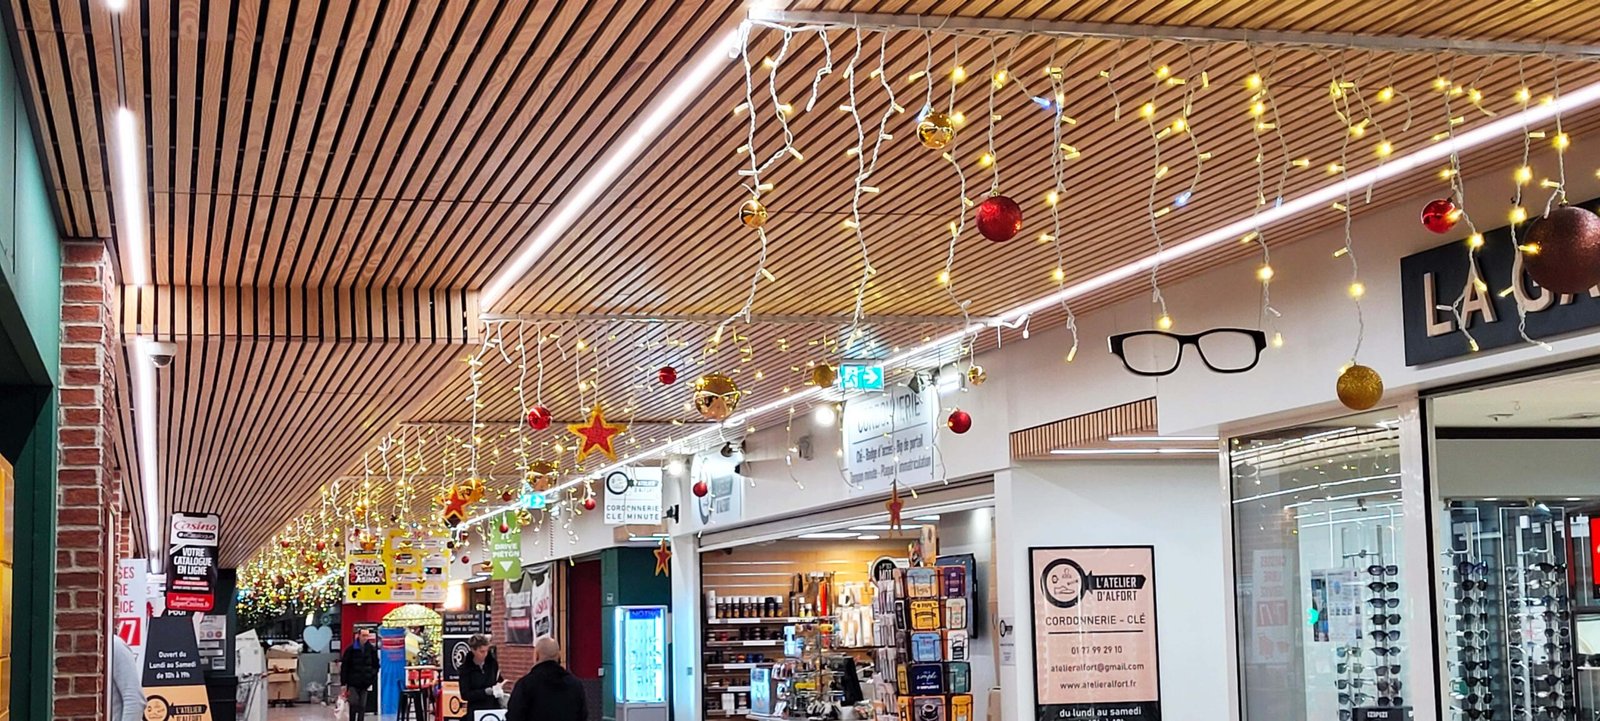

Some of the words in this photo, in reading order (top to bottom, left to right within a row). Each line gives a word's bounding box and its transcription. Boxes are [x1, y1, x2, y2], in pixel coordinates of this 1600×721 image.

[1423, 258, 1502, 338] LA
[173, 521, 217, 532] Casino
[182, 547, 206, 558] VOTRE
[173, 556, 213, 567] CATALOGUE
[177, 566, 187, 575] EN
[188, 567, 208, 576] LIGNE
[1096, 577, 1137, 588] L'ATELIER
[1097, 591, 1138, 601] D'ALFORT
[1045, 615, 1117, 626] CORDONNERIE
[1127, 613, 1146, 624] CLÉ
[158, 650, 178, 659] Ouvert
[1071, 647, 1080, 655] 01
[1092, 646, 1102, 654] 99
[1103, 646, 1113, 654] 29
[1114, 645, 1123, 654] 10
[149, 662, 165, 670] Lundi
[175, 661, 197, 669] Samedi
[1050, 662, 1145, 673] atelieralfort@gmail.com
[1059, 680, 1137, 690] www.atelieralfort.fr
[1059, 709, 1071, 718] du
[1072, 708, 1095, 717] lundi
[1109, 706, 1142, 716] samedi
